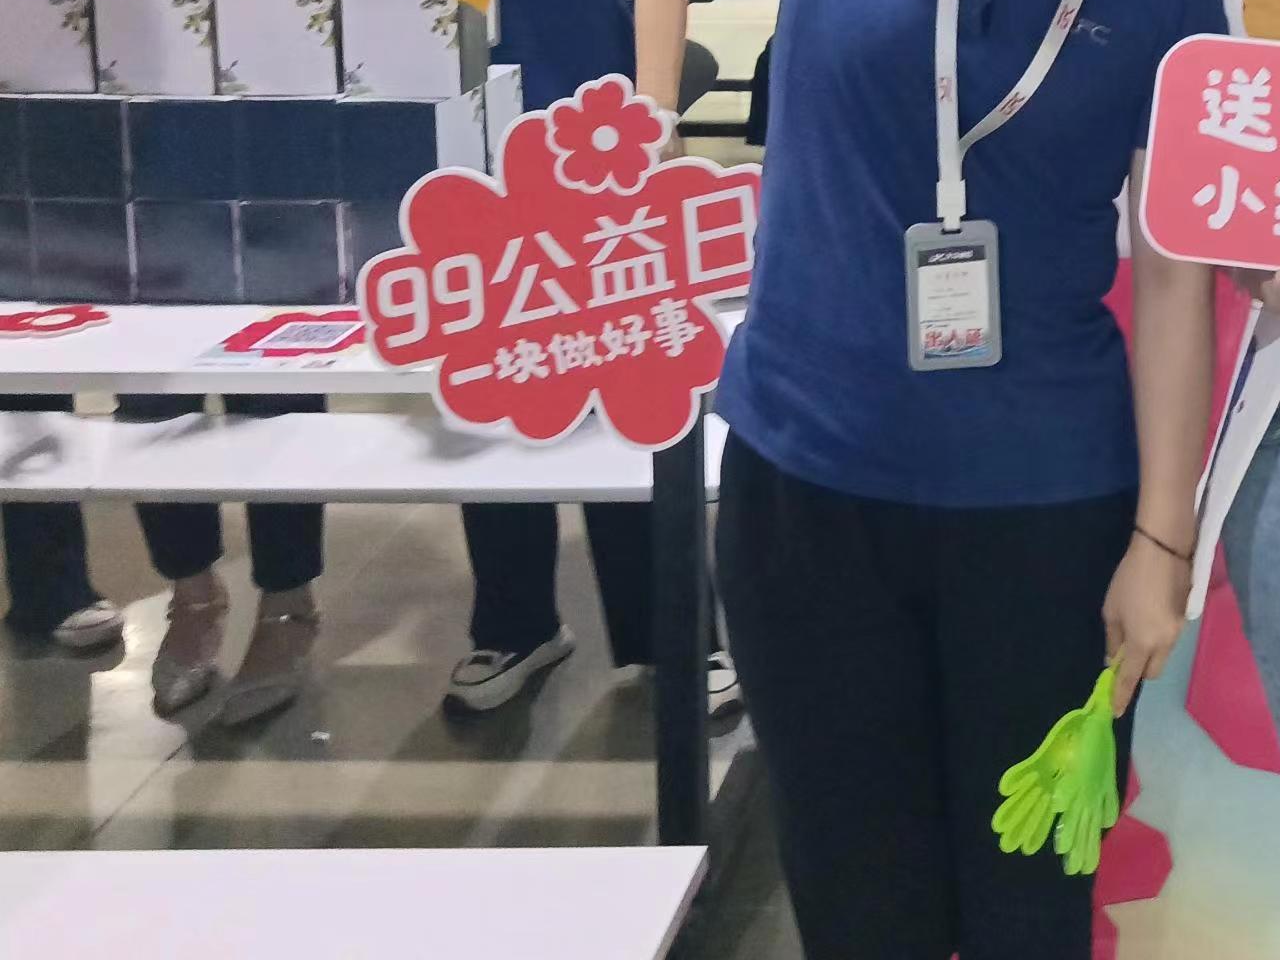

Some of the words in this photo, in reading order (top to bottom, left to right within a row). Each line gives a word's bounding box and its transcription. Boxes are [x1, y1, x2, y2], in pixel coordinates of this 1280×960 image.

[376, 184, 757, 350] 99公益日
[447, 297, 705, 386] 一块做好事
